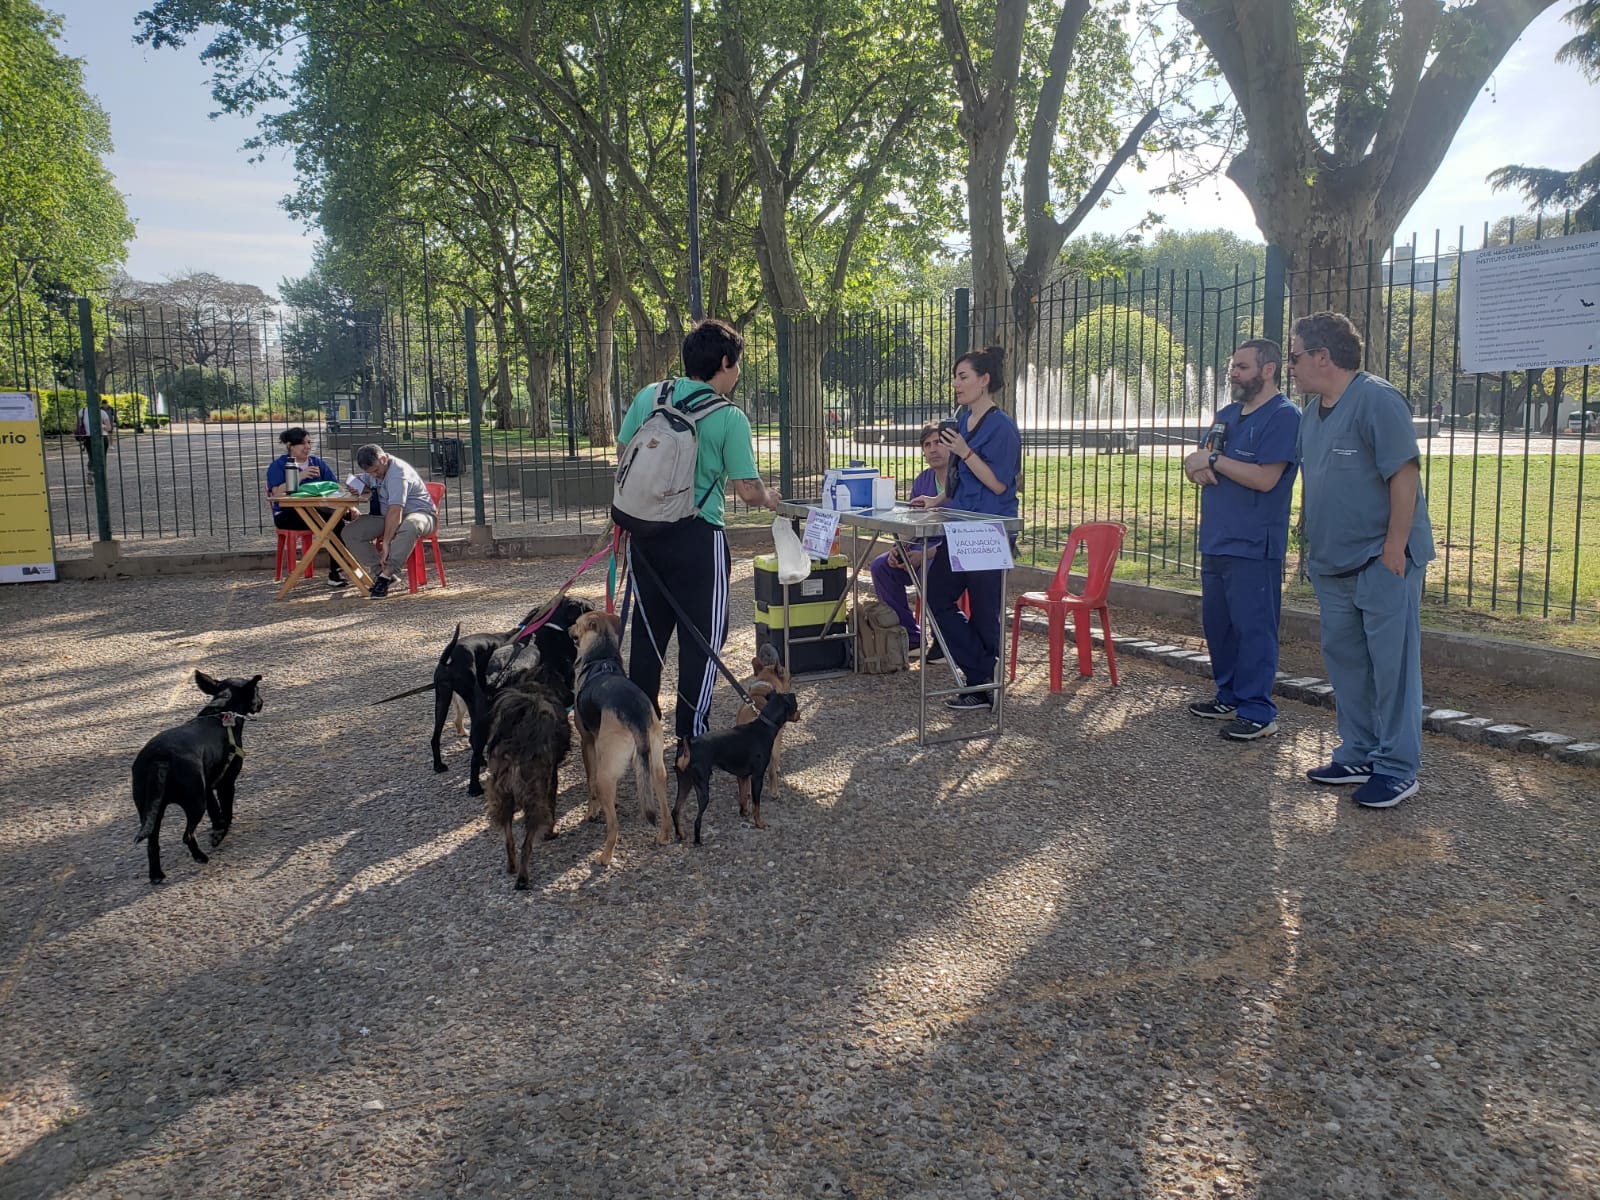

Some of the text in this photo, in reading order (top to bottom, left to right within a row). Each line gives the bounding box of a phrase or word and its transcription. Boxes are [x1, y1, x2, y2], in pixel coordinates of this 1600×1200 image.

[1476, 256, 1507, 264] INSTITUTO
[1517, 249, 1549, 259] ZOONOSIS
[1551, 246, 1565, 254] LUIS
[1493, 247, 1522, 255] HACEMOS
[955, 537, 1001, 547] VACUNACIÓN
